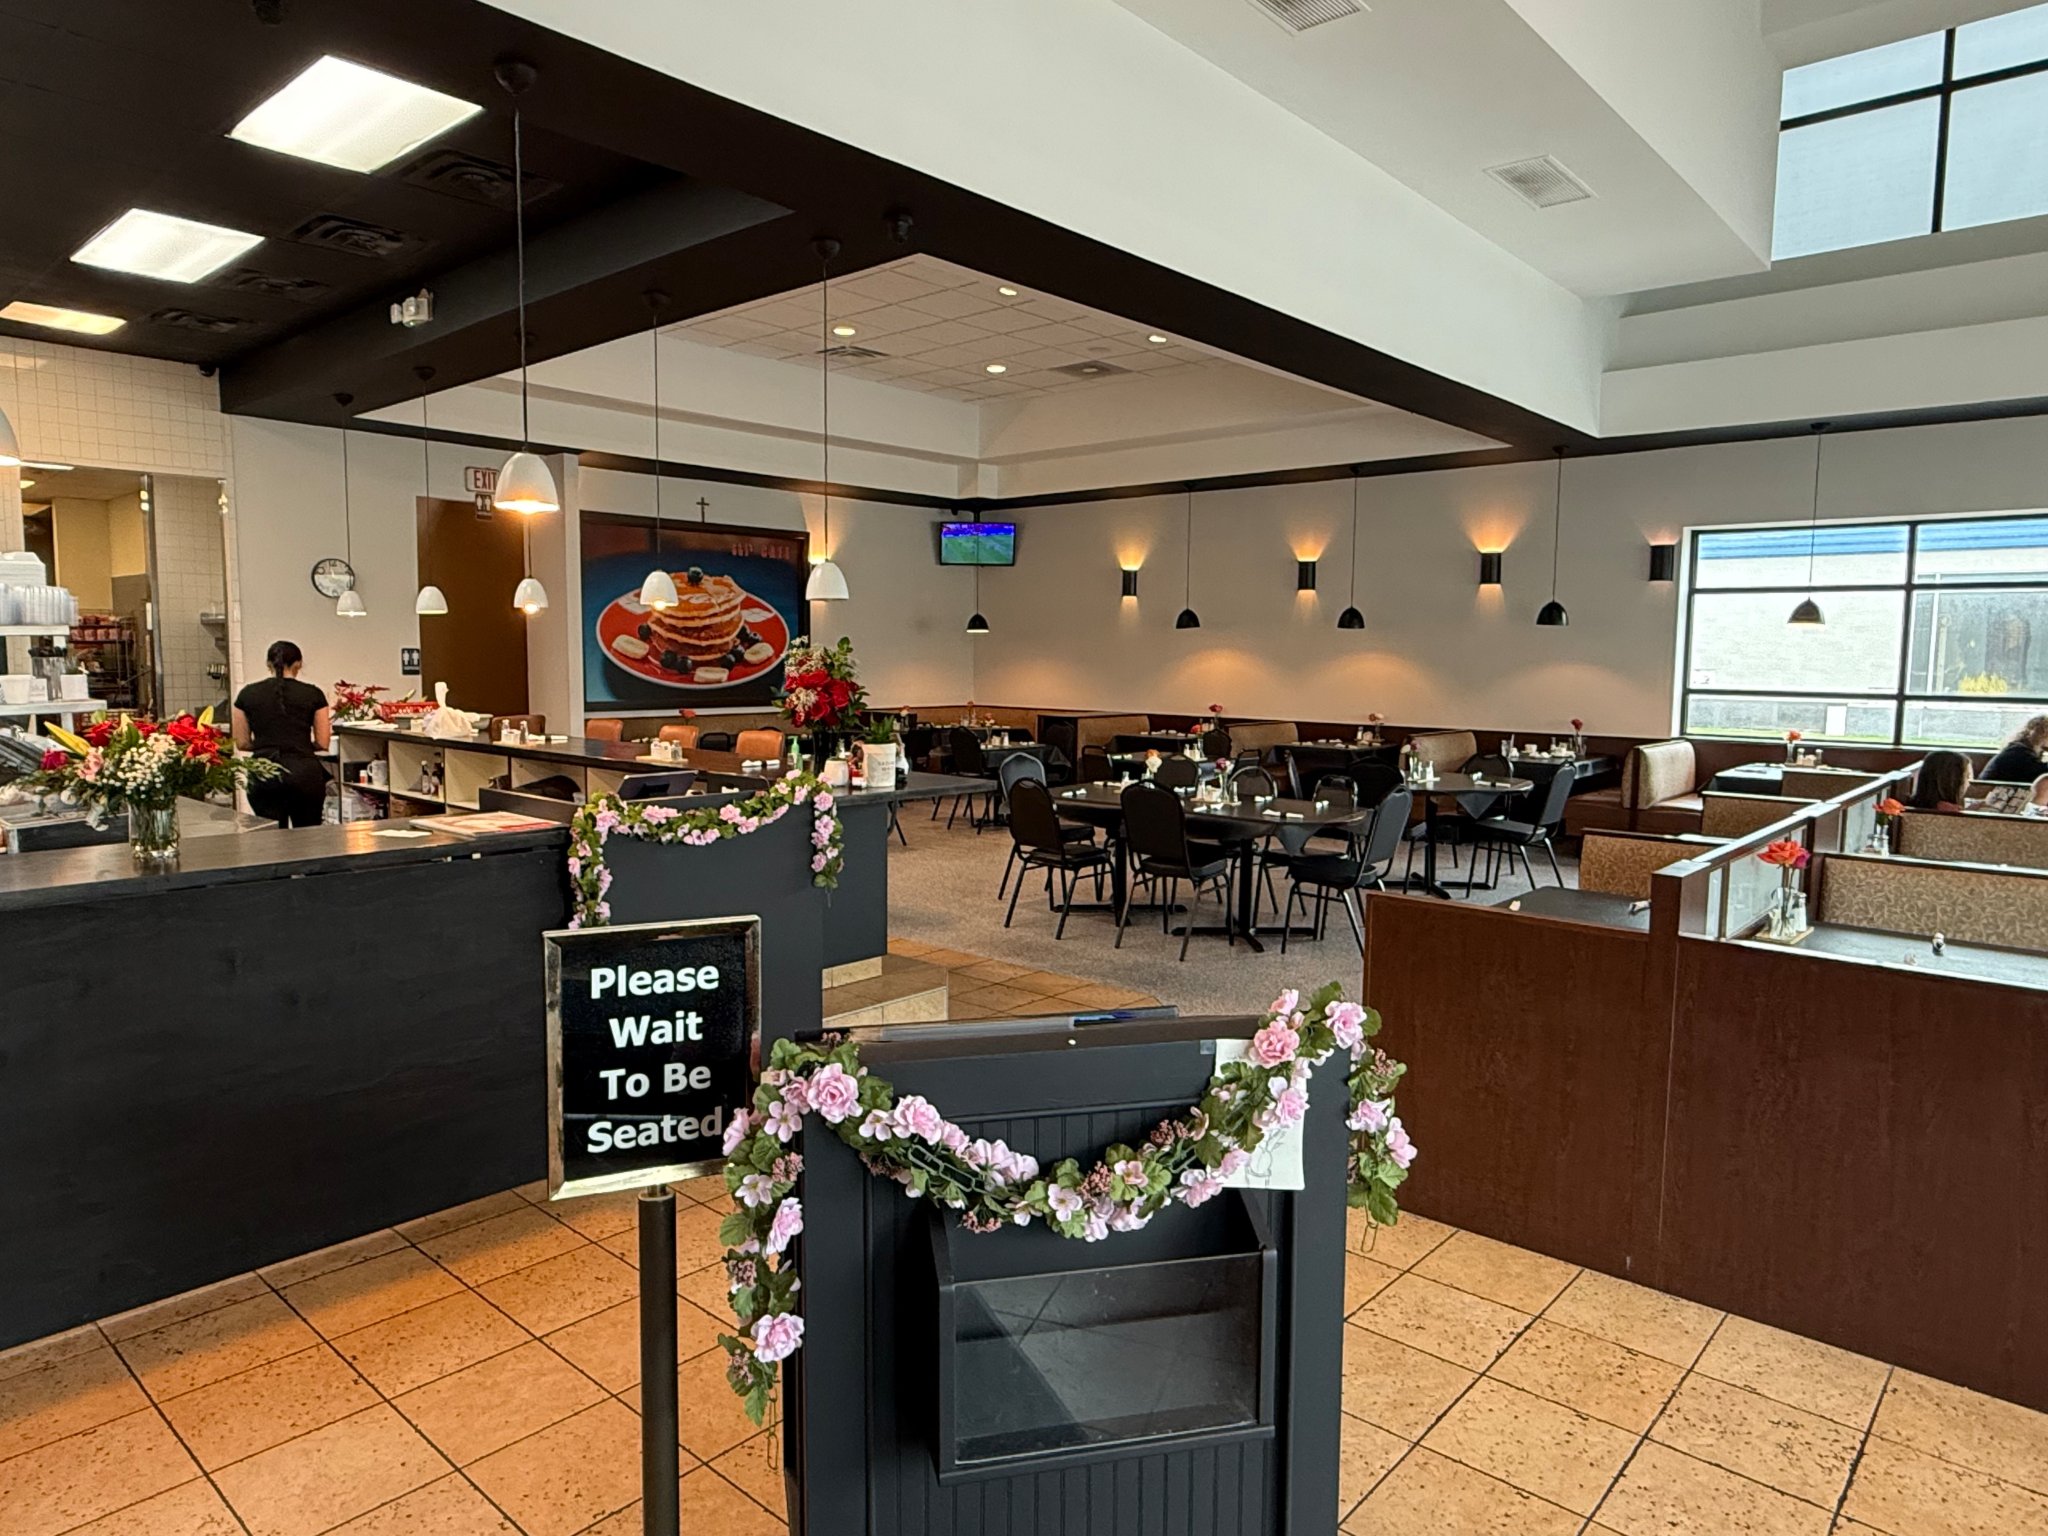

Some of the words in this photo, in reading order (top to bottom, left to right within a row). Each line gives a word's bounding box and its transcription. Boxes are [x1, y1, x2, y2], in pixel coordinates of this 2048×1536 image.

[474, 469, 497, 490] EXIT
[590, 964, 720, 1000] Please
[608, 1010, 703, 1048] Wait
[599, 1068, 650, 1100] To
[663, 1062, 711, 1093] Be
[587, 1106, 723, 1154] Seated
